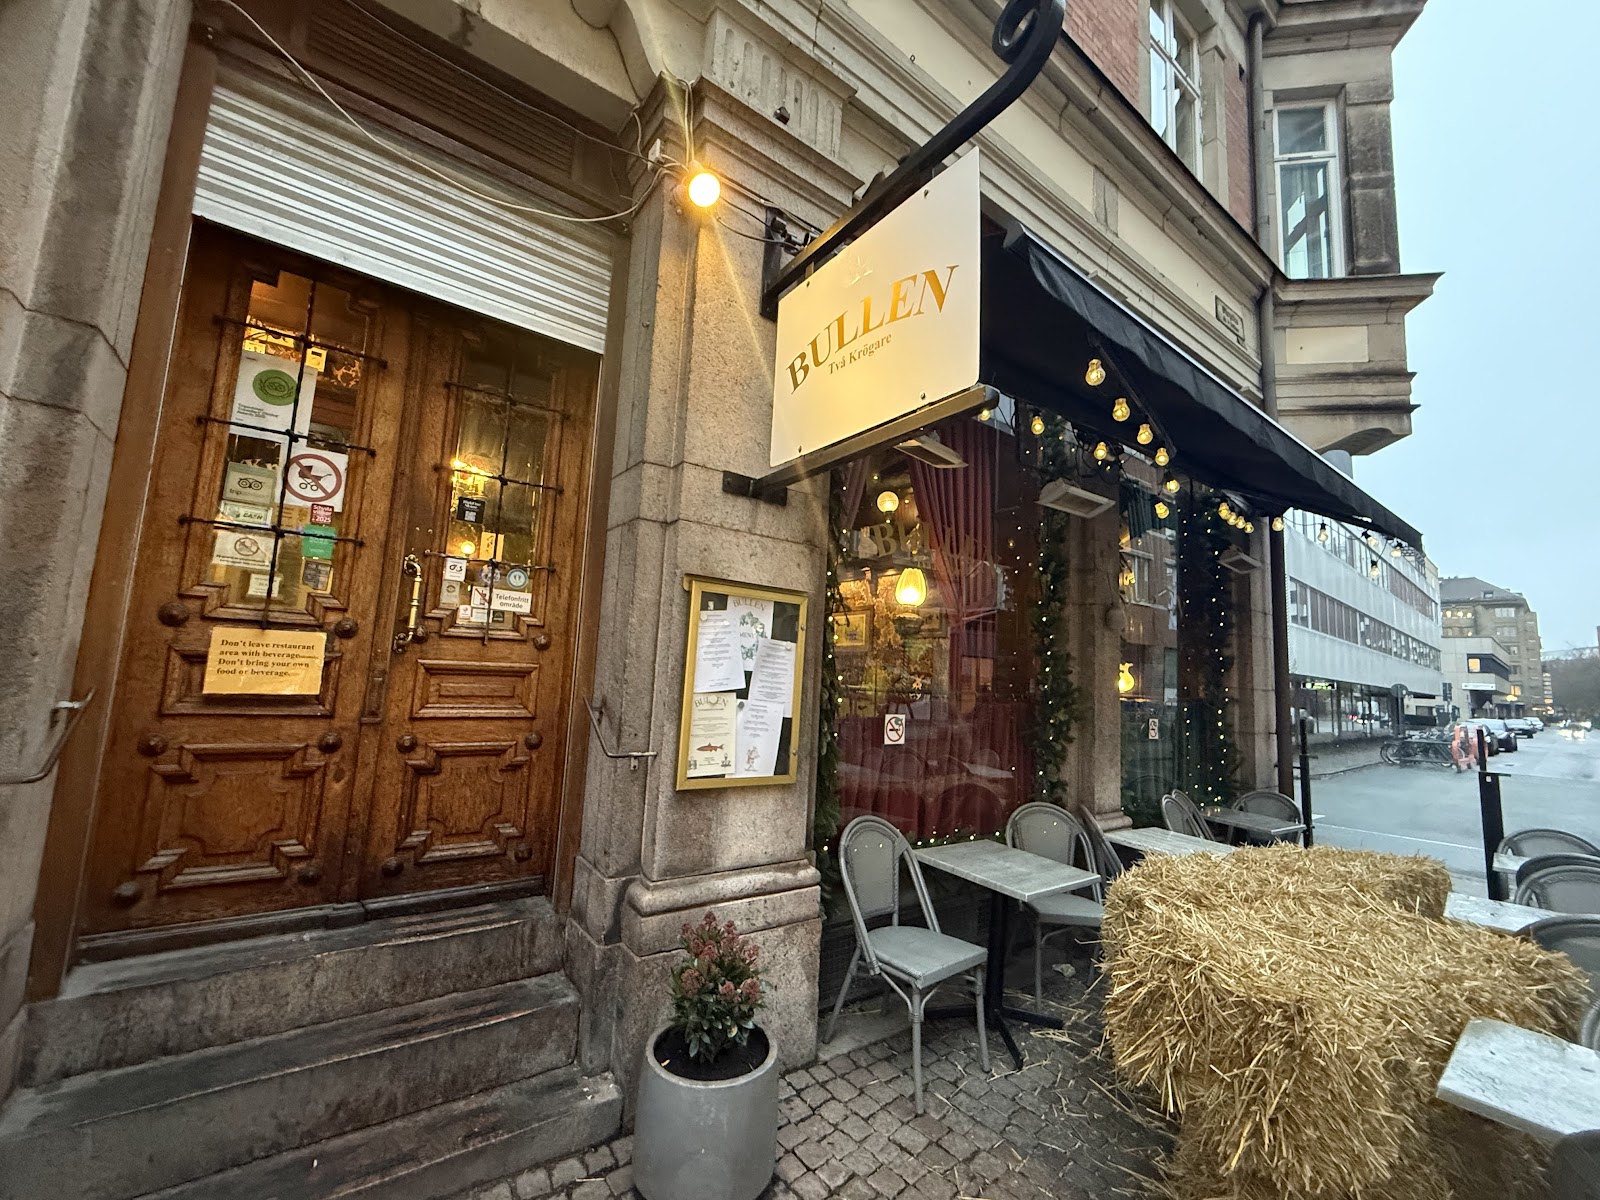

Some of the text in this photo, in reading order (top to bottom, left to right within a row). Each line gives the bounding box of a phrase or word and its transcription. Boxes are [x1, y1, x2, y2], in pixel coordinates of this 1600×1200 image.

[785, 264, 960, 395] BULLEN
[828, 333, 892, 375] Två Krögare
[496, 593, 529, 603] Telefonfritt
[220, 639, 246, 647] Don't
[218, 658, 243, 666] Don't
[245, 659, 269, 668] bring
[694, 696, 727, 708] BULEN
